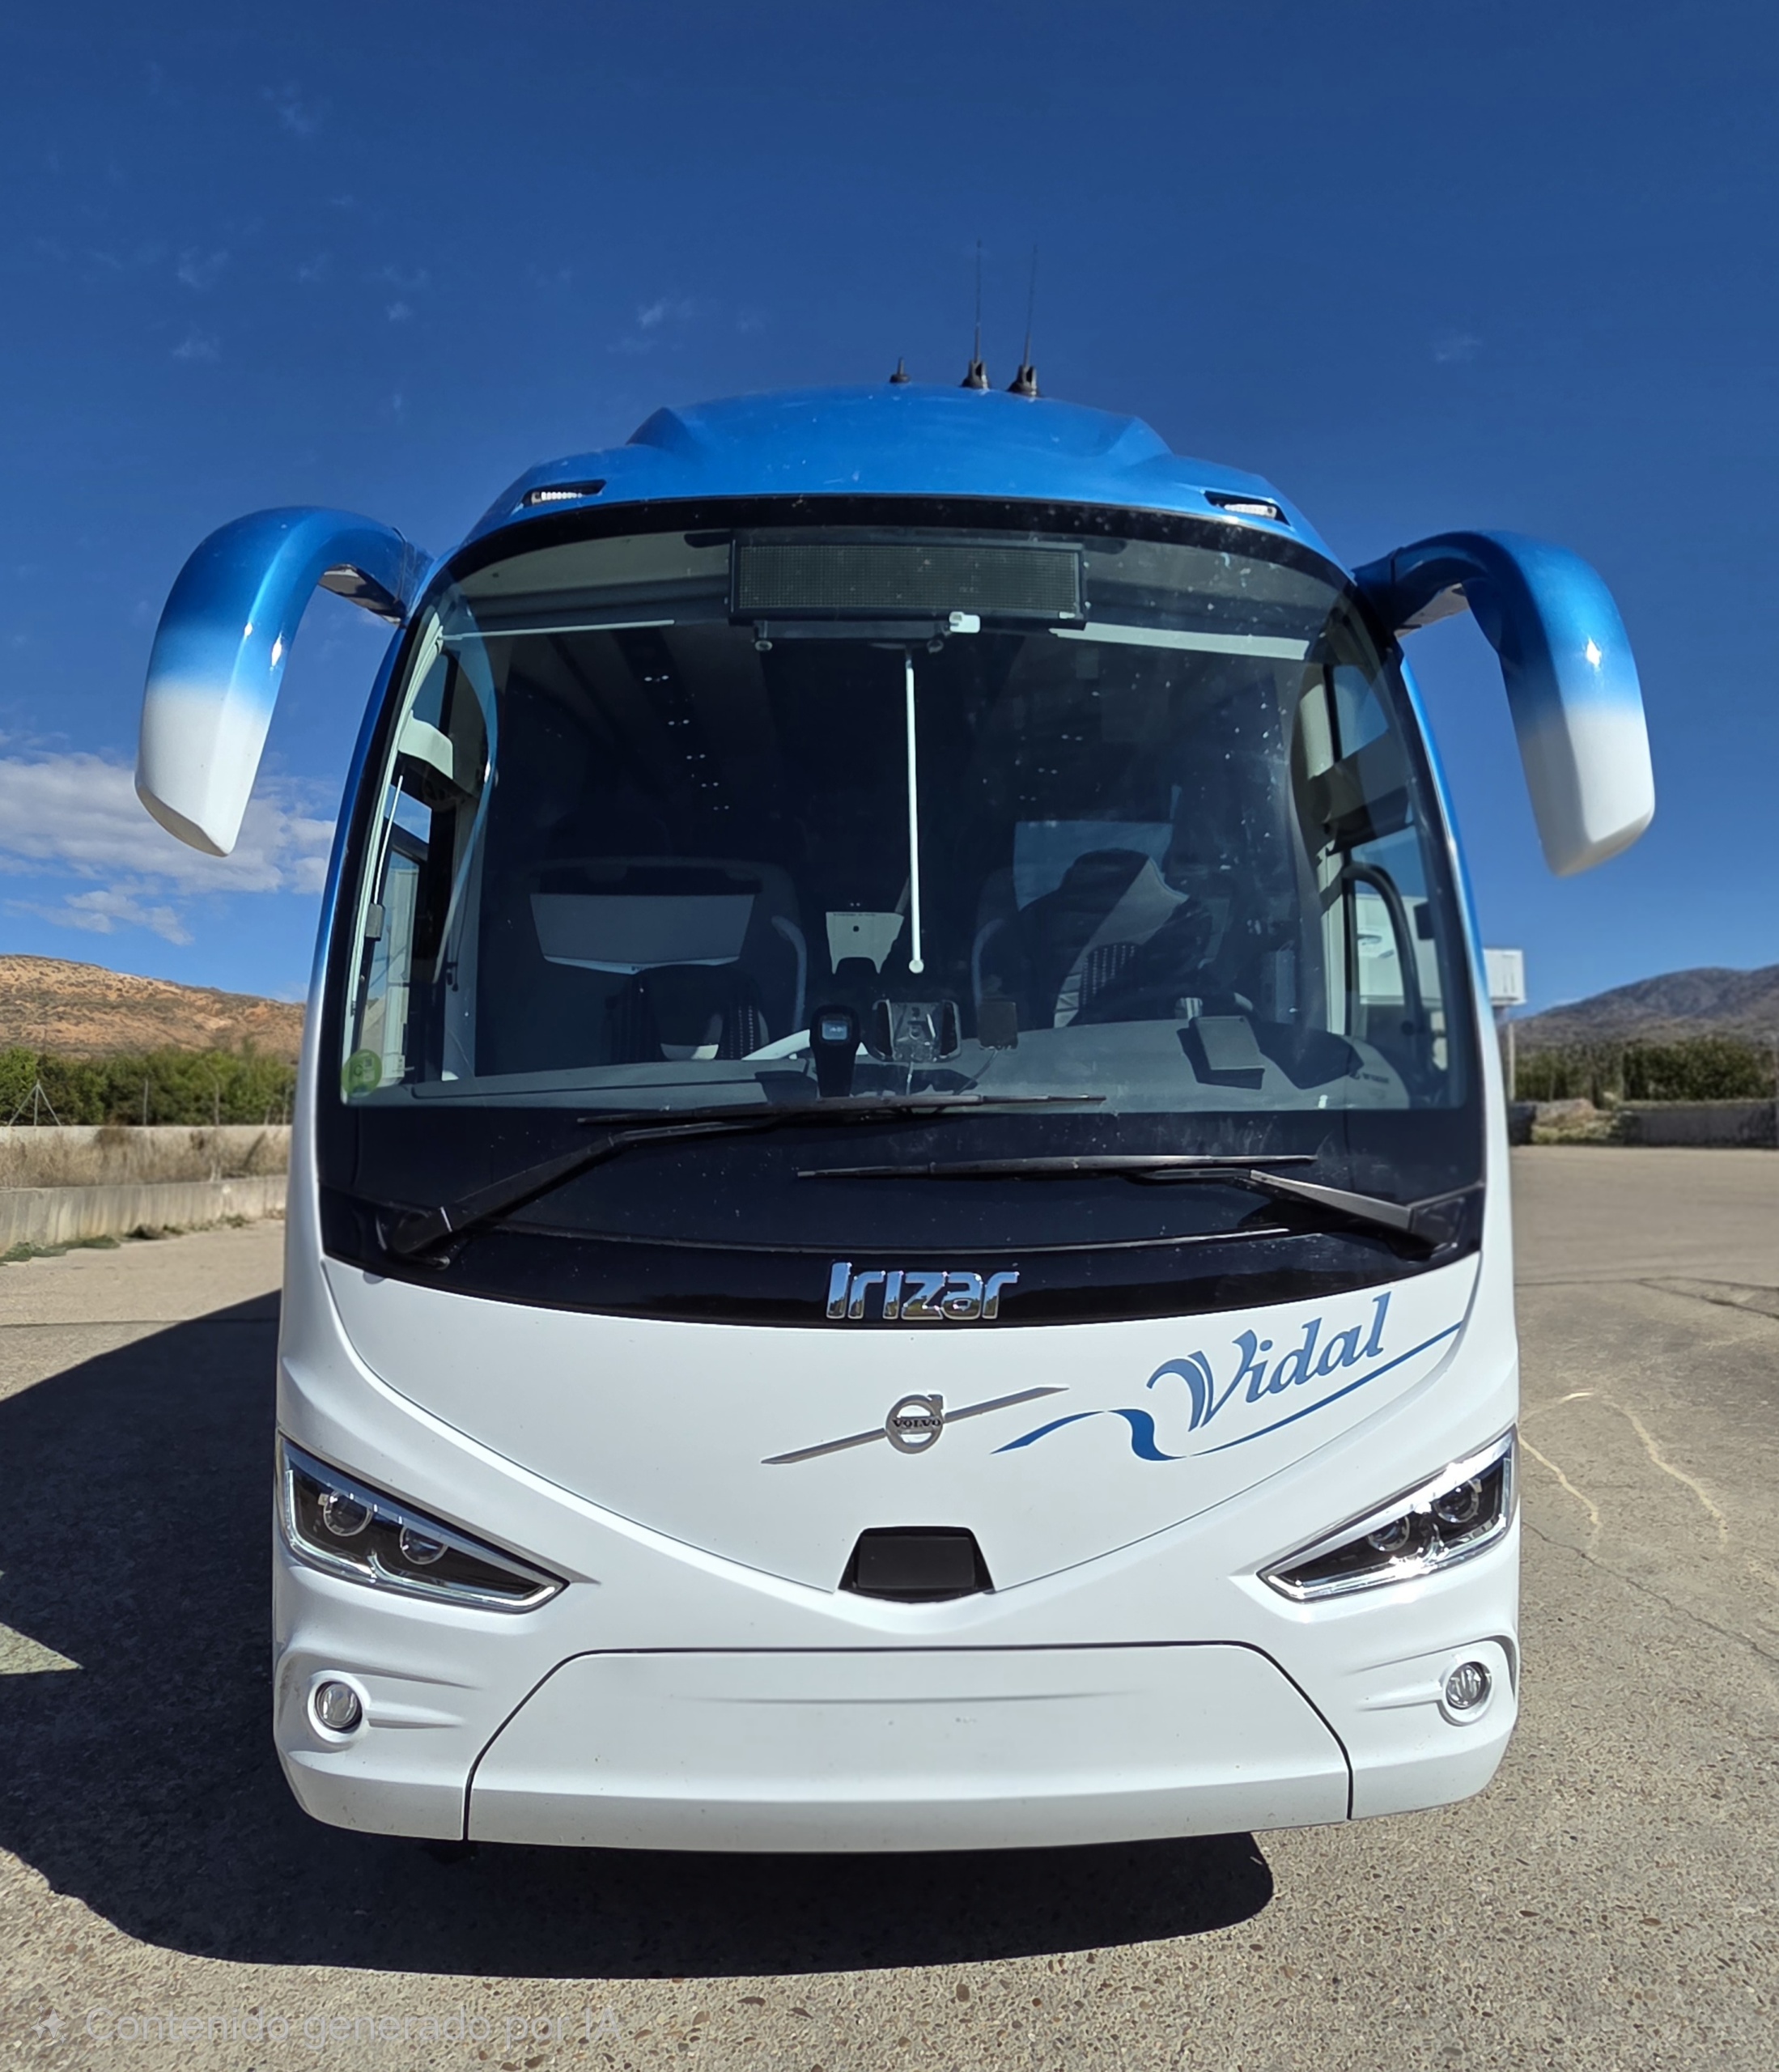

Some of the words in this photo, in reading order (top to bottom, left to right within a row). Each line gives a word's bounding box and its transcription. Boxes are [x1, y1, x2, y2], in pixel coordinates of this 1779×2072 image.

[826, 1261, 1021, 1321] Irizar
[1146, 1290, 1392, 1433] Vidal
[892, 1418, 941, 1428] VOLVO
